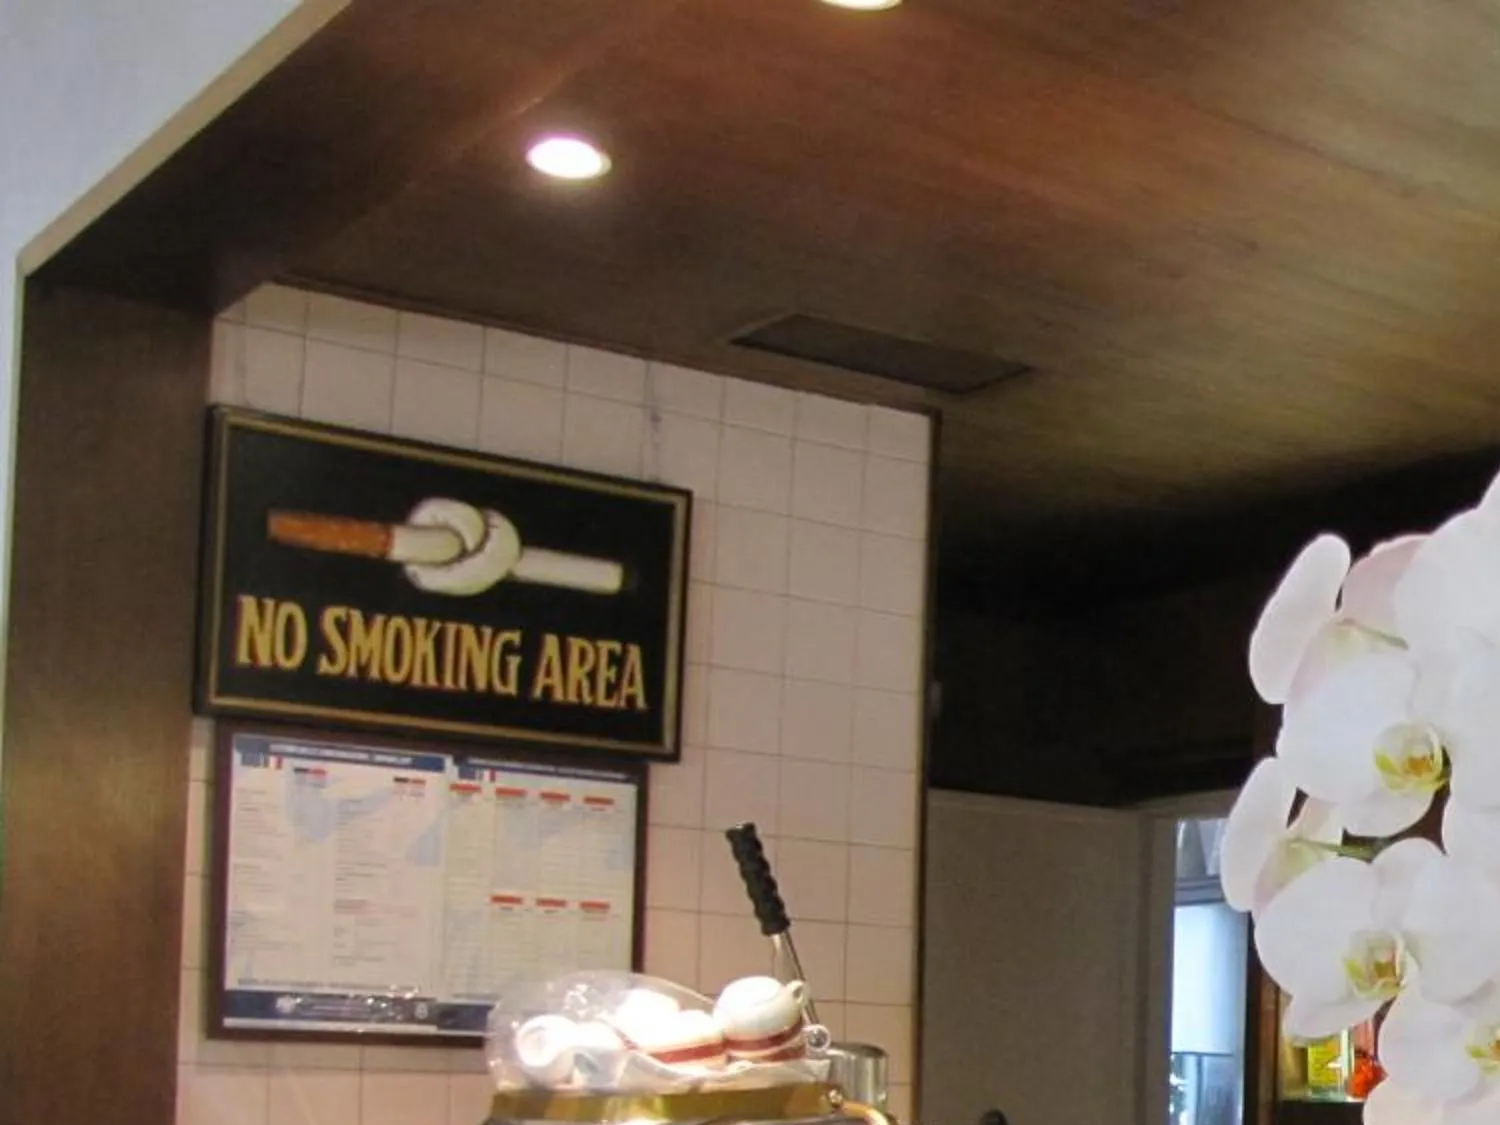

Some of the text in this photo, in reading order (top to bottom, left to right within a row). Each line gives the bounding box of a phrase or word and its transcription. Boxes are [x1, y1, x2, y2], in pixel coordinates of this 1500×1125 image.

[235, 593, 649, 711] NO SMOKING AREA
